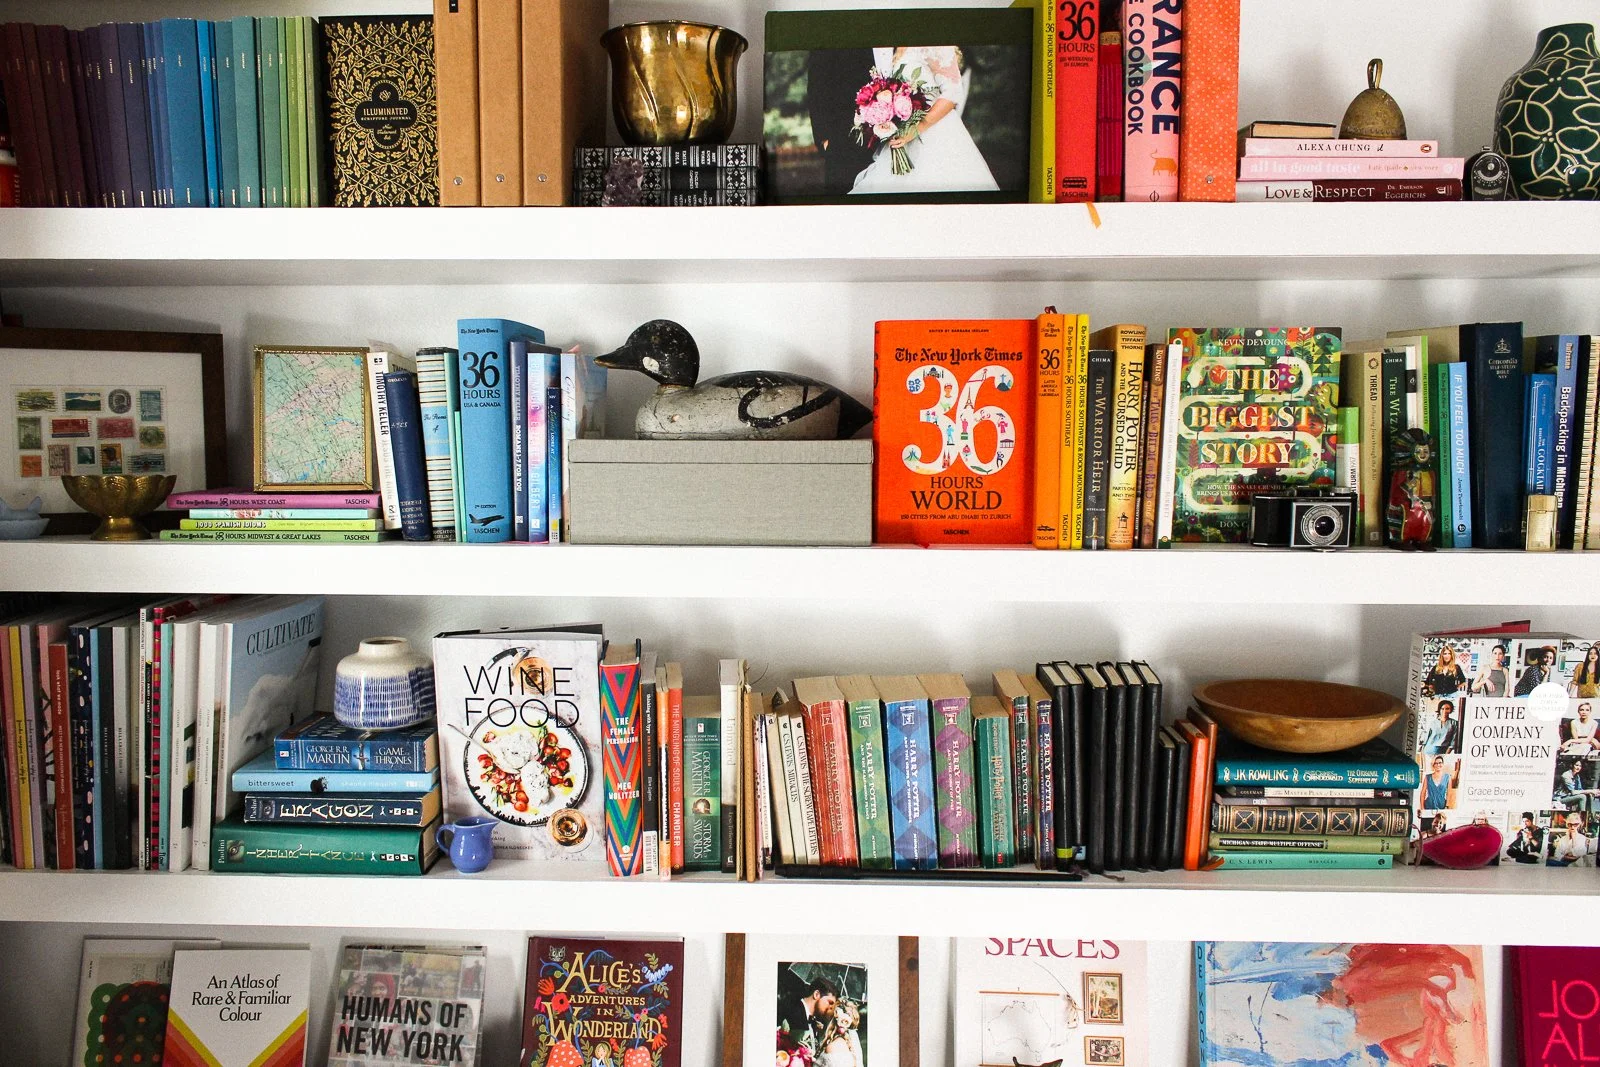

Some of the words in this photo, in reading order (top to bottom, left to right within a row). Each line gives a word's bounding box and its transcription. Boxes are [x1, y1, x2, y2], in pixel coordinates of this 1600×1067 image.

[1058, 1, 1096, 41] 36
[1058, 42, 1095, 52] HOURS
[1128, 13, 1145, 137] COOKBOOK
[363, 108, 408, 116] ILLUMINATED
[1296, 143, 1332, 152] ALEXA
[1334, 144, 1370, 152] CHUNG
[1314, 184, 1376, 198] RESPECT
[895, 348, 918, 363] The
[920, 348, 948, 362] New
[950, 348, 982, 365] York
[985, 348, 1023, 361] Times
[1040, 349, 1060, 369] 36
[1154, 349, 1164, 382] ROWLING
[462, 351, 500, 388] 36
[1217, 369, 1280, 390] THE
[1454, 374, 1464, 382] IF
[463, 389, 500, 399] HOURS
[1095, 377, 1104, 395] THE
[1127, 362, 1142, 411] HARRY
[1369, 374, 1377, 401] THREAD
[1389, 377, 1398, 395] THE
[1454, 385, 1464, 402] YOU
[902, 365, 1015, 475] 36
[1116, 393, 1126, 433] CURSED
[1189, 406, 1315, 428] BIGGEST
[1454, 404, 1464, 426] FEEL
[1556, 386, 1572, 452] Backpacking
[1092, 397, 1105, 457] WARRIOR
[1455, 429, 1464, 446] TOO
[1114, 436, 1124, 469] CHILD
[1124, 417, 1140, 474] POTTER
[1200, 442, 1296, 464] STORY
[1456, 448, 1465, 474] MUCH
[1536, 448, 1546, 490] COCKTAIL
[1557, 454, 1568, 464] in
[931, 476, 983, 489] HOURS
[1092, 460, 1103, 492] HEIR
[1555, 466, 1566, 508] Michigan
[911, 490, 1002, 510] WORLD
[246, 613, 316, 656] CULTIVATE
[463, 665, 575, 696] WINE
[1411, 668, 1419, 682] IN
[1408, 685, 1418, 711] THE
[465, 698, 580, 728] FOOD
[1475, 707, 1491, 720] IN
[1494, 706, 1525, 720] THE
[672, 720, 680, 753] MINGLING
[726, 717, 736, 766] Uninvited
[1472, 725, 1543, 739] COMPANY
[307, 752, 350, 764] MARTIN
[374, 756, 412, 765] THRONES
[378, 747, 404, 755] GAME
[673, 754, 680, 766] OF
[866, 742, 875, 779] HARRY
[952, 740, 961, 774] HARRY
[1471, 744, 1490, 758] OF
[1495, 744, 1551, 758] WOMEN
[692, 751, 703, 796] MARTIN
[703, 751, 711, 780] GEORGE
[1248, 770, 1289, 782] ROWLING
[673, 767, 681, 792] SOULS
[829, 740, 838, 783] HARRY
[834, 787, 843, 832] POTTER
[1468, 787, 1491, 796] Grace
[1495, 787, 1525, 797] Bonney
[280, 804, 374, 819] ERAGON
[693, 820, 703, 859] SWORDS
[703, 823, 712, 853] STORM
[808, 827, 818, 855] LETTERS
[556, 951, 643, 994] ALICE'S
[1197, 946, 1203, 978] DE
[206, 975, 228, 990] An
[230, 974, 264, 989] Atlas
[265, 973, 281, 989] of
[191, 992, 224, 1006] Rare
[225, 992, 236, 1006] &
[238, 990, 292, 1006] Familiar
[568, 994, 646, 1006] ADVENTURES
[219, 1006, 263, 1022] Colour
[341, 995, 432, 1026] HUMANS
[439, 1002, 468, 1028] OF
[541, 1001, 662, 1047] WONDERLAND
[596, 1008, 614, 1016] IN
[336, 1026, 393, 1056] NEW
[402, 1030, 464, 1062] YORK
